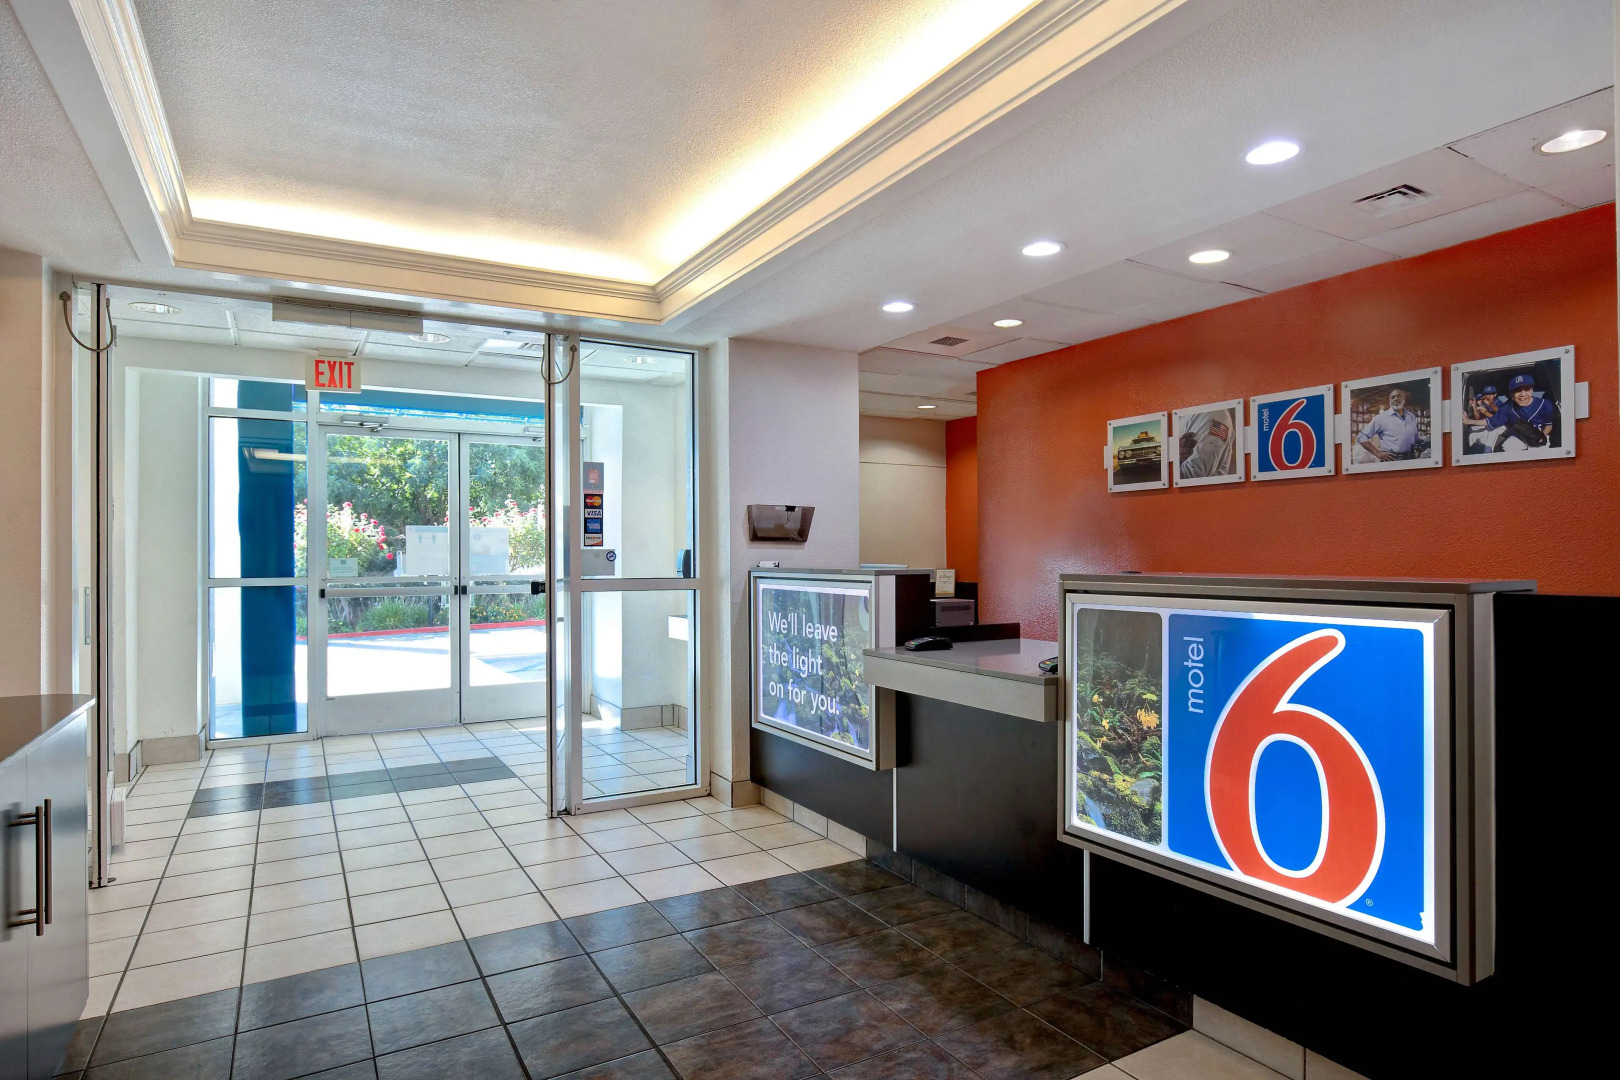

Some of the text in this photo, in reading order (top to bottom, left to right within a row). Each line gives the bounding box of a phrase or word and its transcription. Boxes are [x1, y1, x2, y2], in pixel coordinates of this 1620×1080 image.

[314, 359, 355, 389] EXIT
[1262, 398, 1317, 472] motel 6
[768, 610, 838, 642] We'll leave
[768, 642, 823, 678] the light
[768, 680, 784, 699] on
[787, 678, 807, 705] for
[1183, 628, 1386, 908] motel 6
